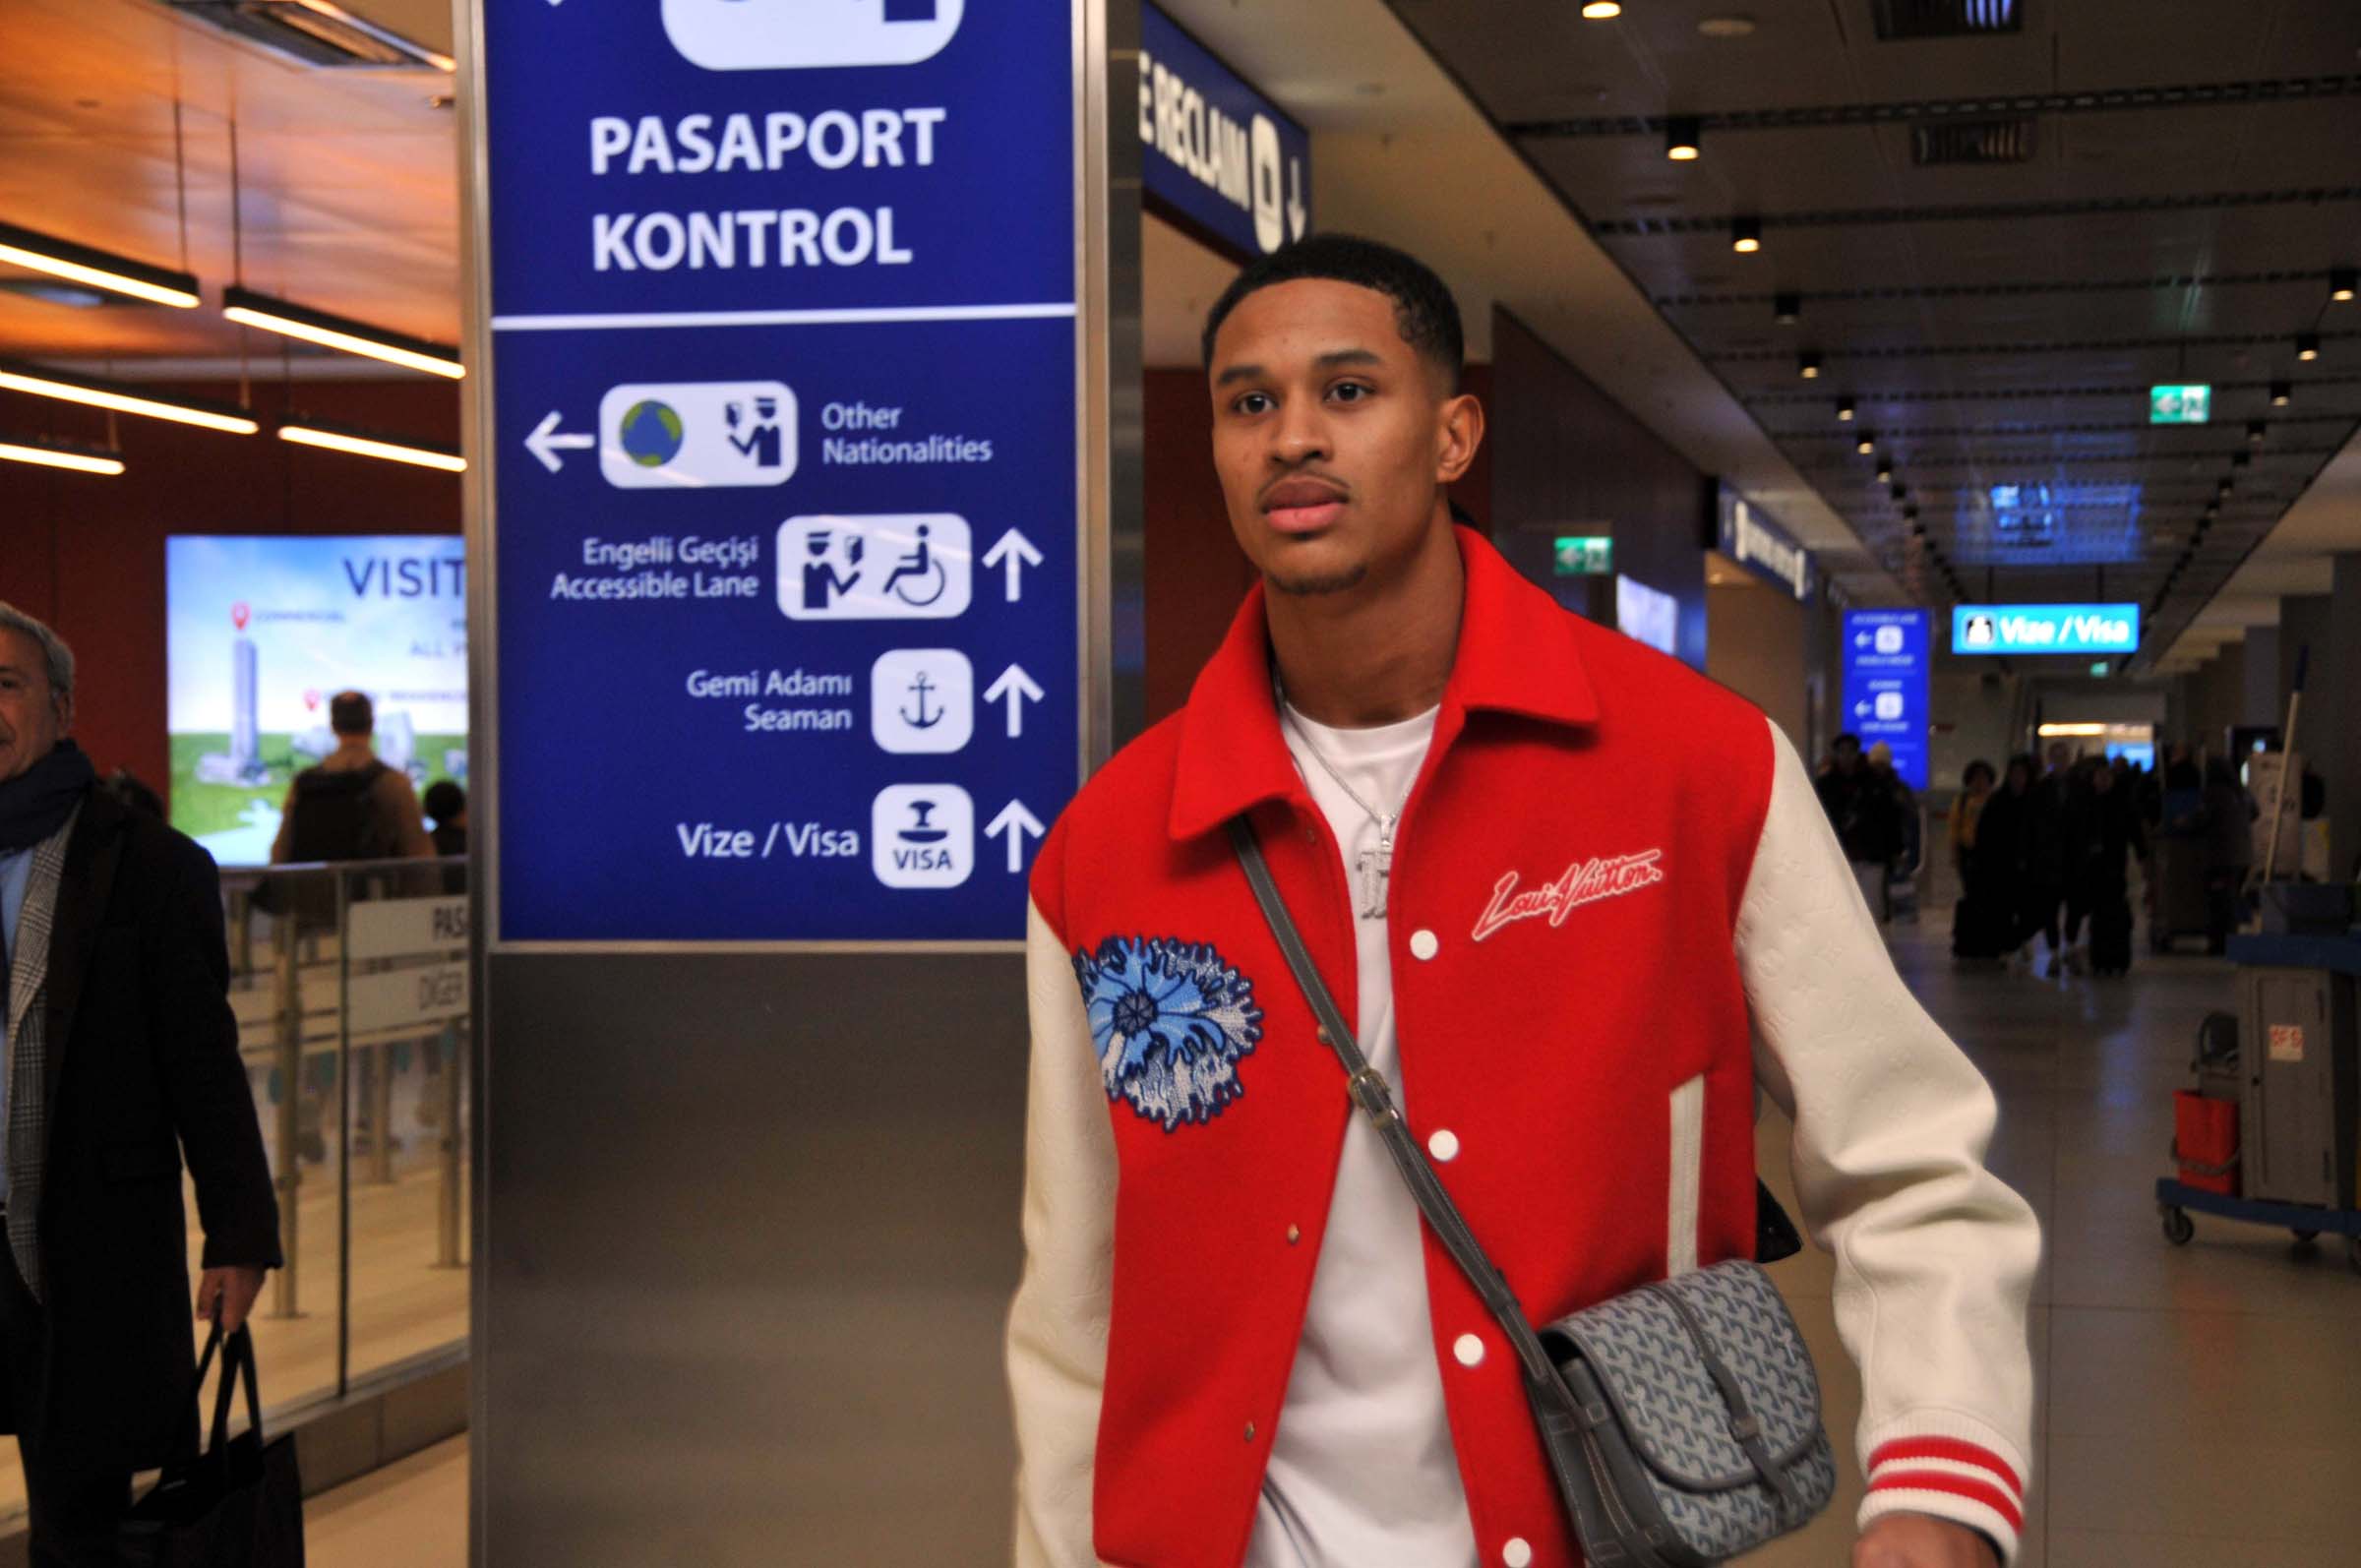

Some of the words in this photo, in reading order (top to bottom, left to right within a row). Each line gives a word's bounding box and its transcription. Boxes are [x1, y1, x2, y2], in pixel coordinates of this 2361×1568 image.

[589, 106, 947, 176] PASAPORT
[592, 206, 914, 271] KONTROL
[820, 400, 902, 431] Other
[821, 433, 995, 464] Nationalities
[582, 535, 675, 572] Engelli
[678, 535, 759, 570] Geçişi
[344, 558, 465, 598] VISIT
[550, 570, 690, 600] Accessible
[694, 571, 759, 598] Lane
[686, 668, 760, 698] Gemi
[764, 667, 853, 697] Adamı
[744, 701, 853, 733] Seaman
[676, 821, 756, 859] Vize
[760, 821, 780, 859] /
[784, 821, 861, 858] Visa
[892, 847, 954, 872] VISA
